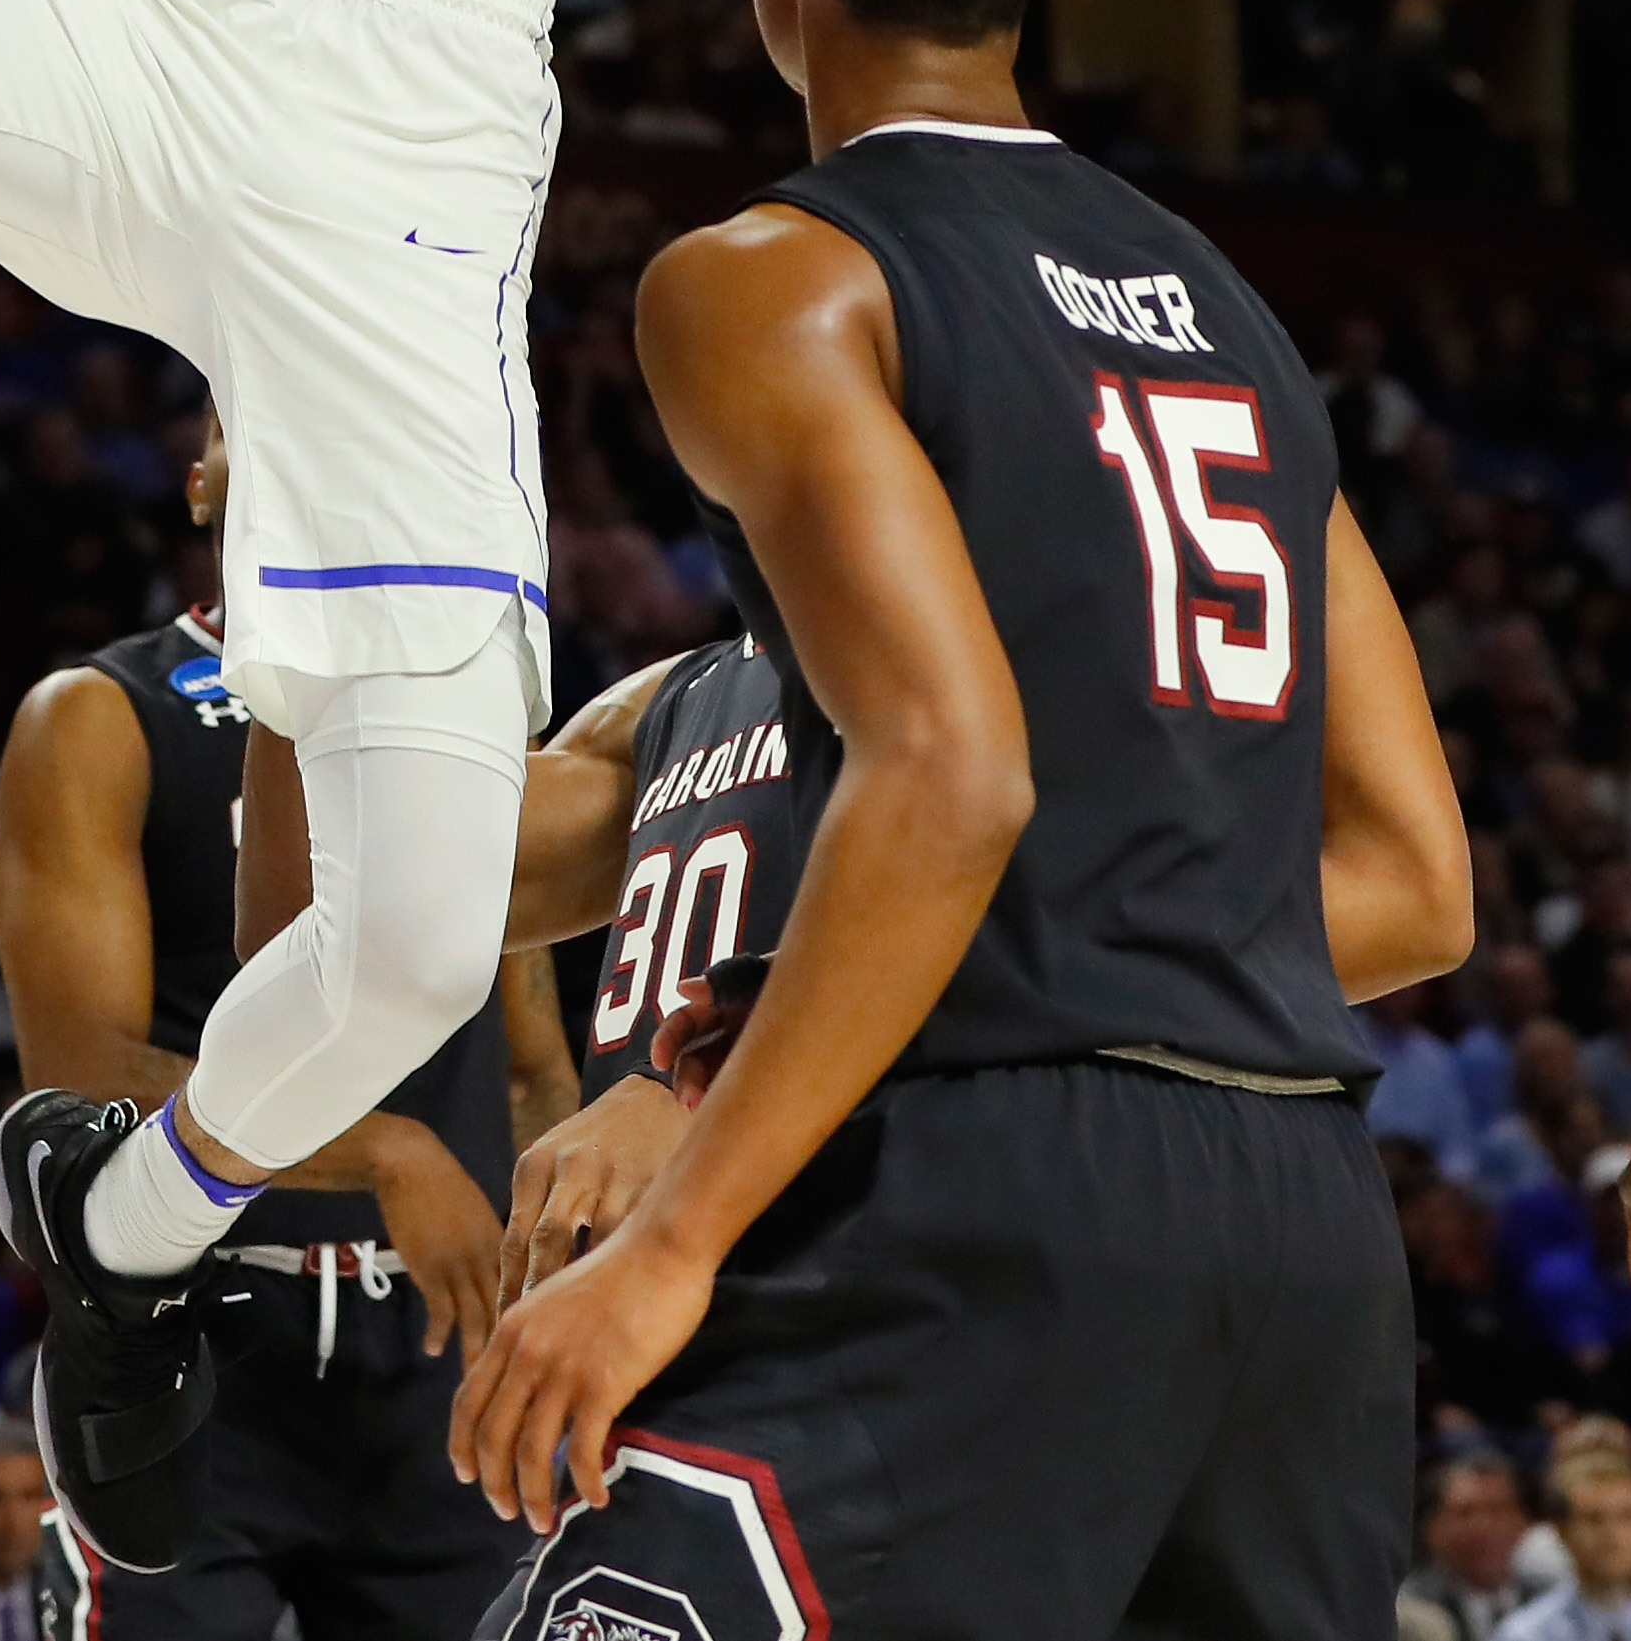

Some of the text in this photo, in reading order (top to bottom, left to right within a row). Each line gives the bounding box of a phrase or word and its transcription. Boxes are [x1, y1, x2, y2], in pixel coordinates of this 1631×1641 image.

[1034, 253, 1215, 353] DOZIER
[1087, 368, 1299, 723] 15
[591, 820, 755, 1055] 30
